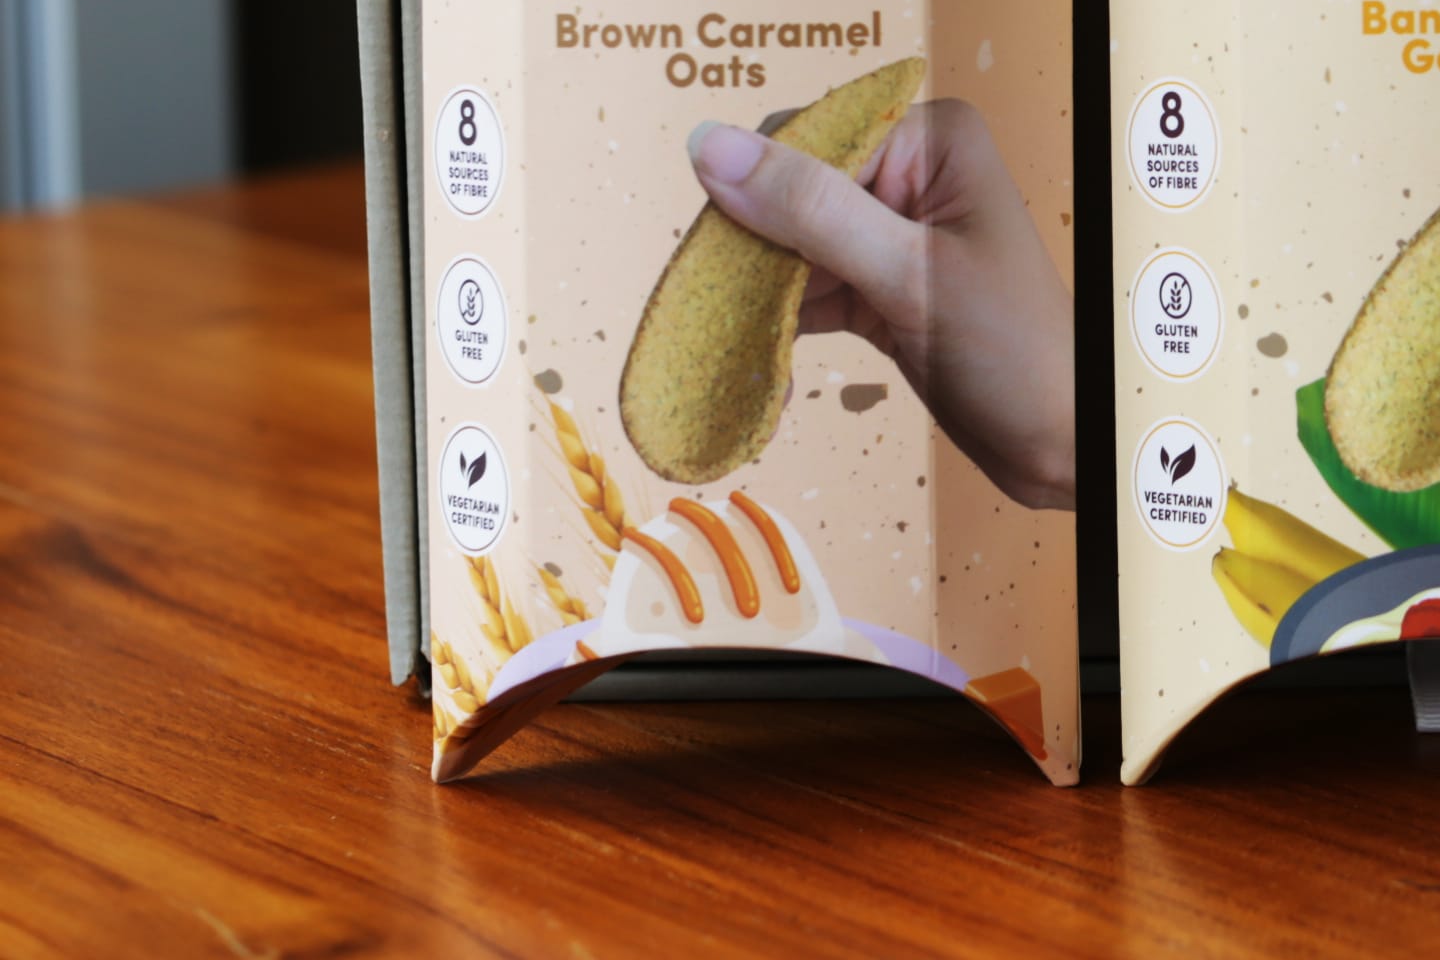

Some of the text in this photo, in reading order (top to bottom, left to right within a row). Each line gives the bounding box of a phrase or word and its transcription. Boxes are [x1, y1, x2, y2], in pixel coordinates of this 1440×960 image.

[555, 10, 882, 49] Brown Caramel
[665, 52, 766, 88] Oats
[459, 99, 477, 146] 8
[1160, 92, 1185, 138] 8
[449, 151, 488, 165] NATURAL
[1148, 144, 1198, 157] NATURAL
[449, 167, 488, 181] SOURCES
[1147, 159, 1199, 174] SOURCES
[1149, 176, 1198, 189] OF FIBRE
[450, 183, 488, 198] OF FIBRE
[455, 329, 488, 344] GLUTEN
[1155, 324, 1198, 338] GLUTEN
[462, 346, 482, 360] FREE
[1164, 341, 1190, 354] FREE
[448, 495, 500, 514] VEGETARIAN
[1144, 491, 1213, 509] VEGETARIAN
[451, 512, 495, 531] CERTIFIED
[1150, 508, 1207, 525] CERTIFIED
